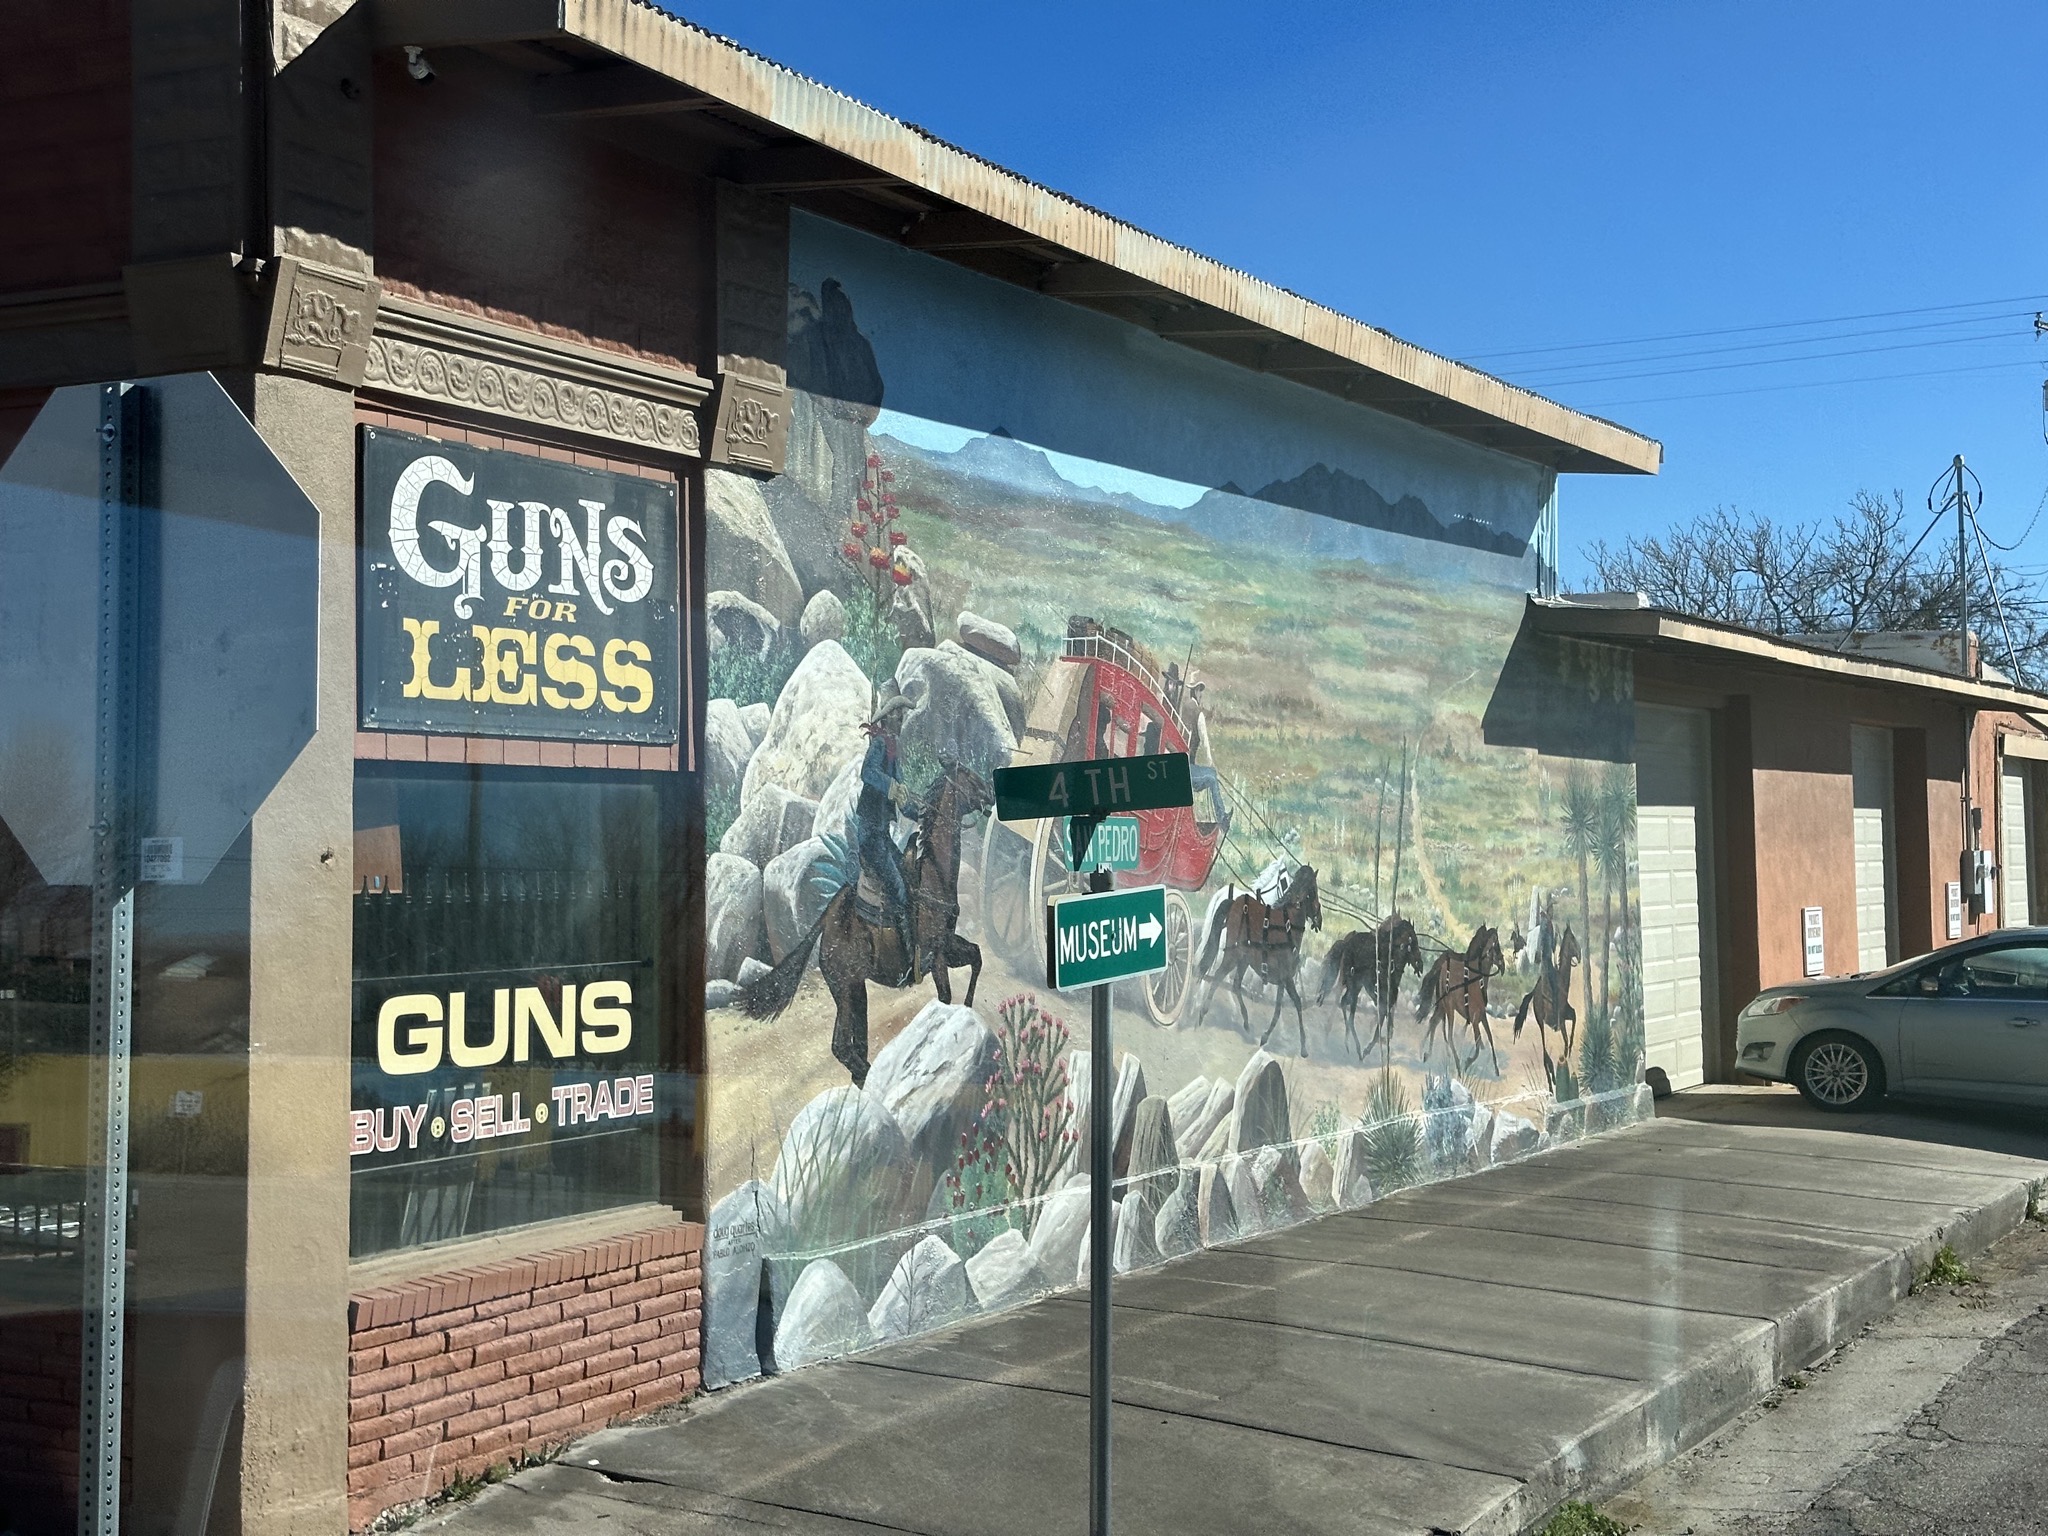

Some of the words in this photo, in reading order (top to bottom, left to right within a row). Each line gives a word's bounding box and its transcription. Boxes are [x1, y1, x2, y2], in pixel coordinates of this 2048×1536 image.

[503, 597, 578, 623] FOR
[403, 618, 654, 714] LESS
[1049, 771, 1069, 808] 4
[1084, 766, 1131, 805] TH
[1147, 760, 1168, 781] ST
[1098, 825, 1138, 862] PEDRO
[1060, 916, 1137, 965] MUSEUM
[377, 980, 633, 1075] GUNS
[350, 1104, 428, 1155] BUY
[451, 1092, 531, 1143] SELL
[552, 1074, 654, 1126] TRADE
